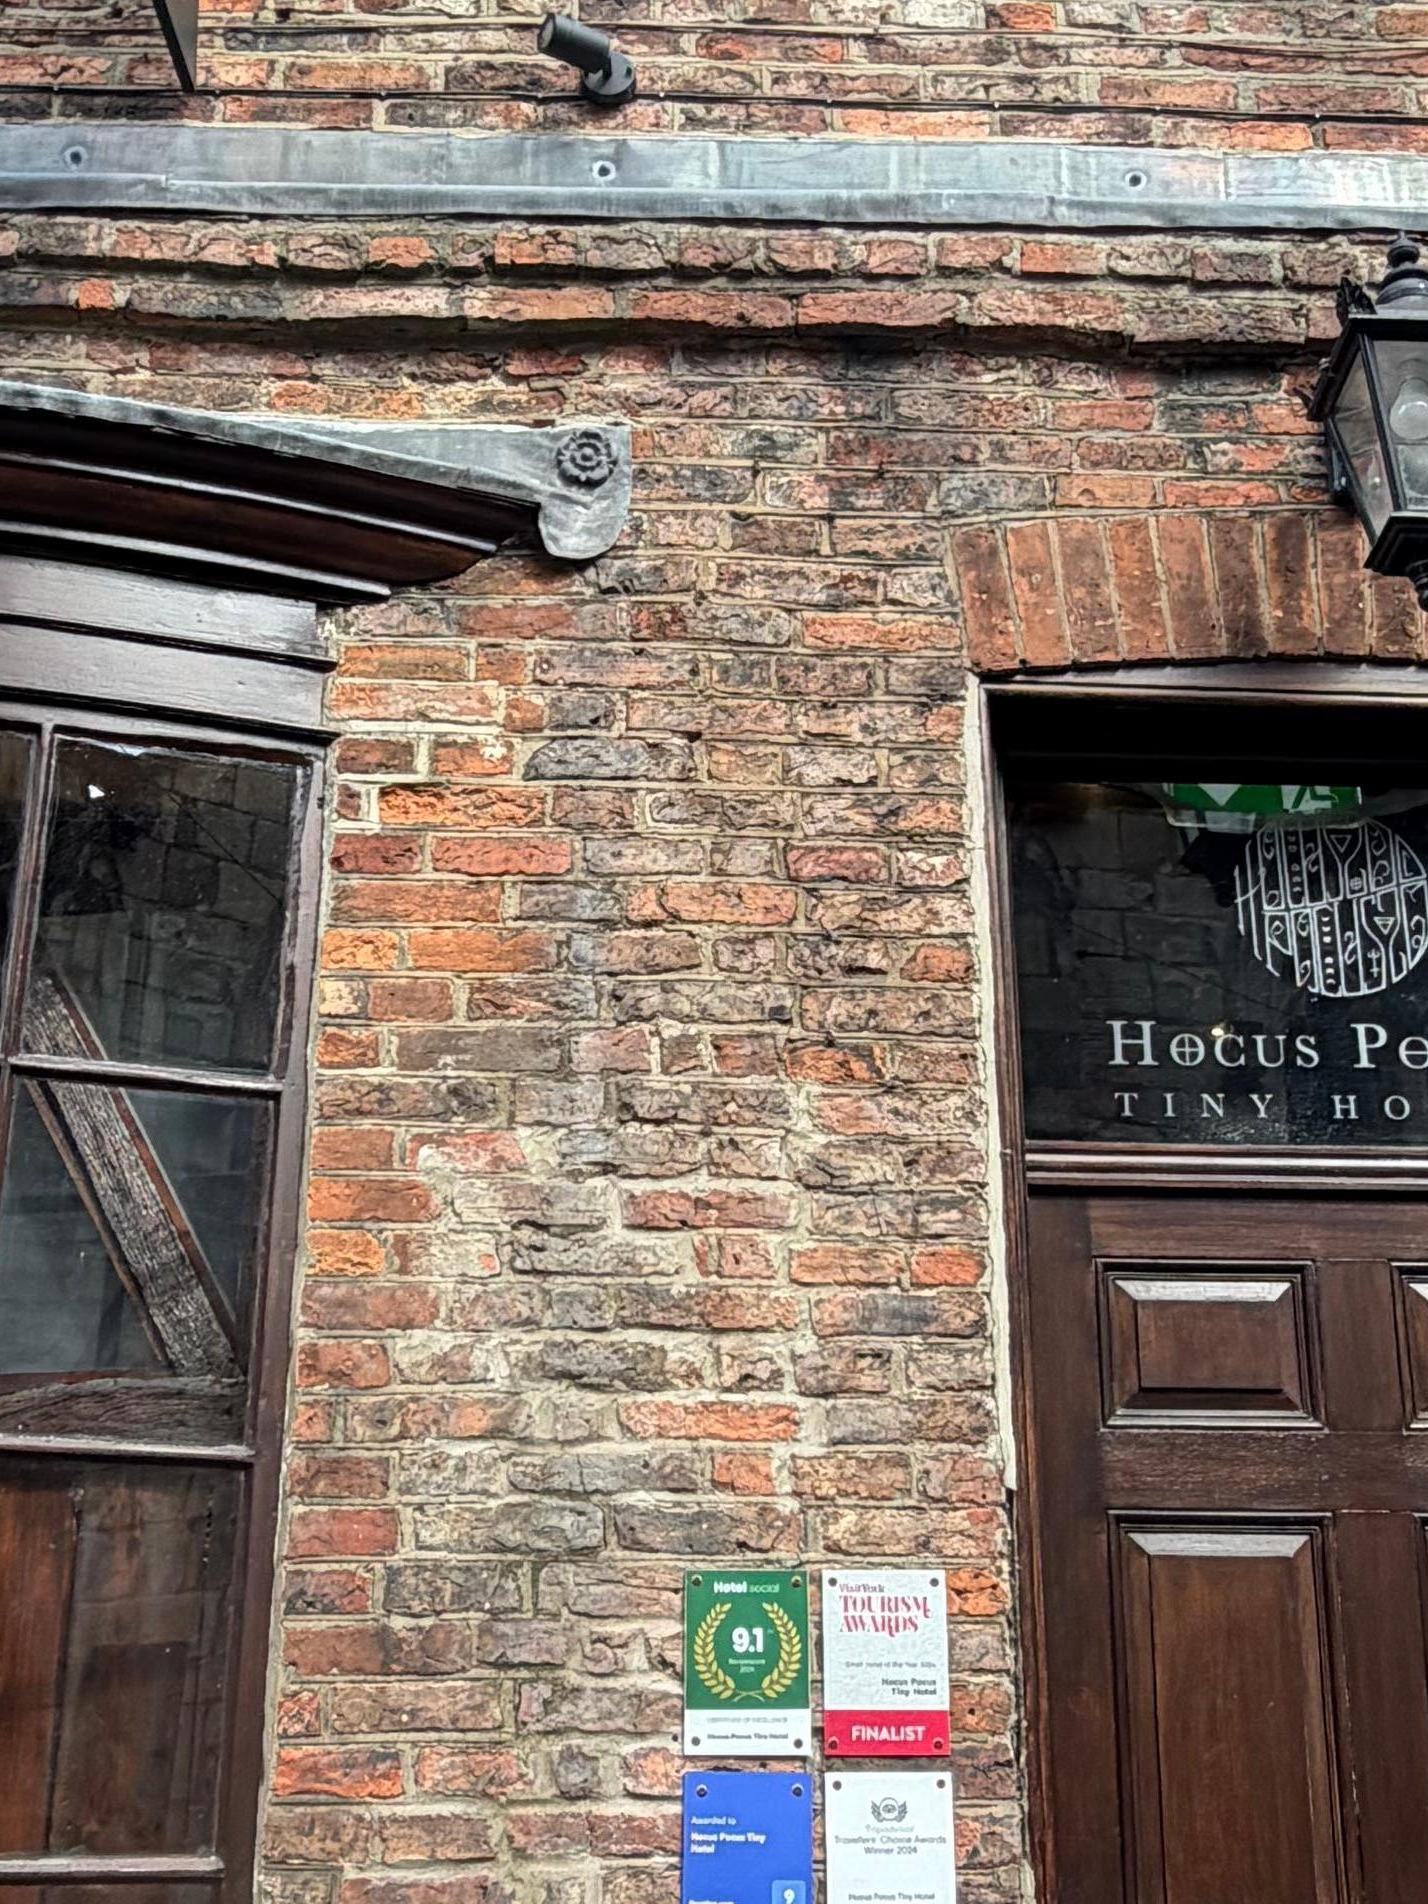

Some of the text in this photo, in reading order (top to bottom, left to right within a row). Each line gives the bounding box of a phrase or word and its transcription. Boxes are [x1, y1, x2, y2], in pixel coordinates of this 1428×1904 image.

[1114, 1092, 1273, 1118] TINY
[713, 1581, 747, 1594] Hotel
[839, 1595, 932, 1619] TOURISM
[839, 1615, 919, 1638] AWARDS
[732, 1626, 764, 1653] 9.1
[851, 1725, 927, 1742] FINALIST
